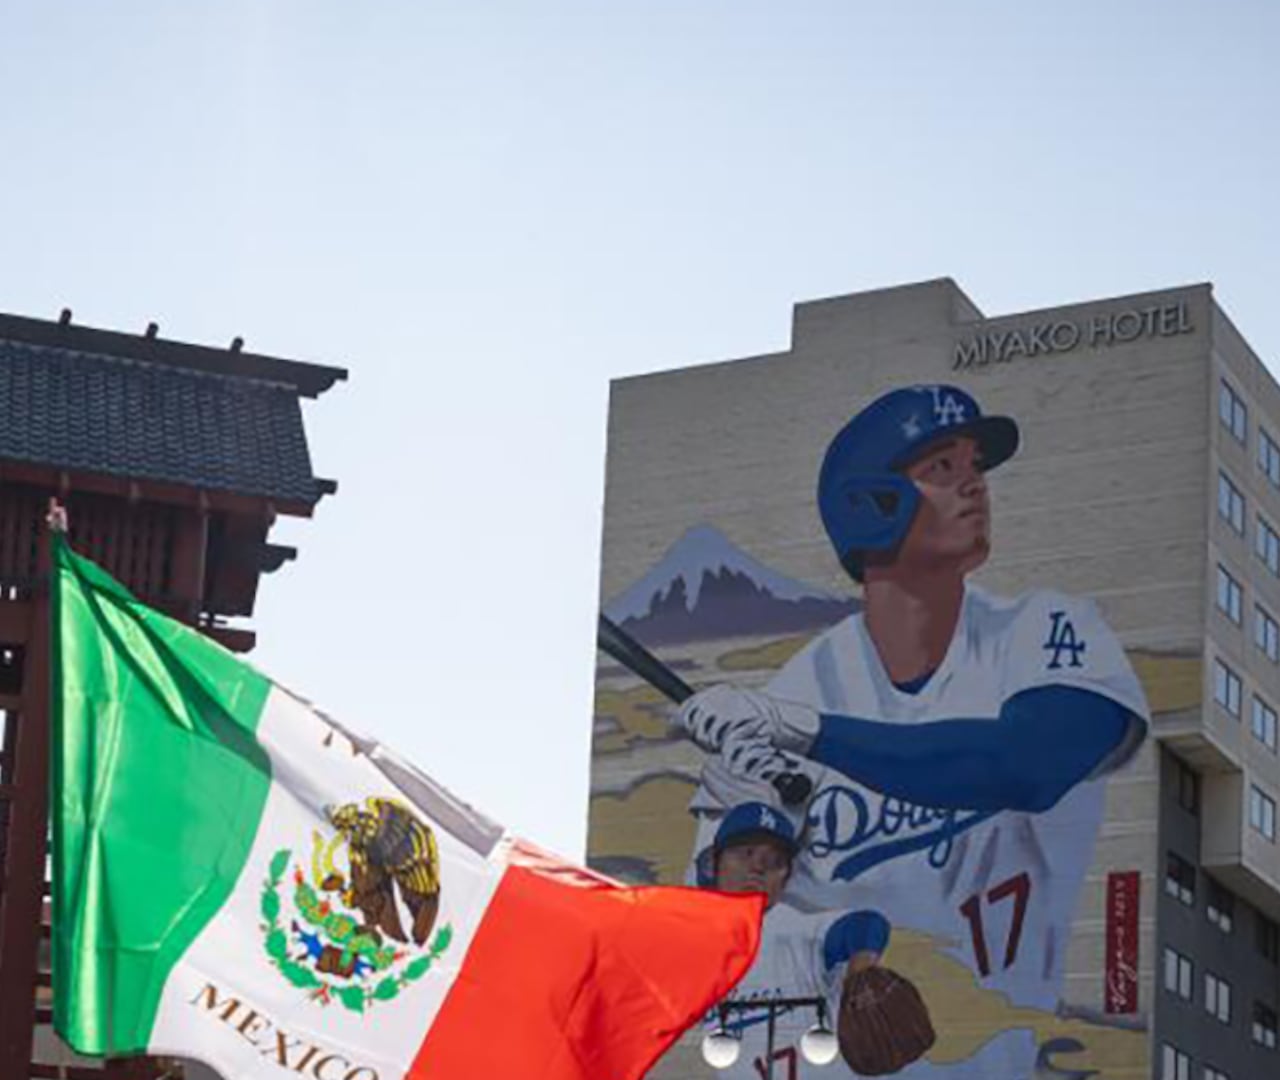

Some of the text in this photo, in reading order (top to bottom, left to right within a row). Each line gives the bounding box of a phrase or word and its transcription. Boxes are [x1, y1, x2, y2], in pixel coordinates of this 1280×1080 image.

[952, 302, 1193, 370] MIYAKO HOTEL
[930, 387, 965, 425] LA
[1042, 611, 1086, 669] LA
[958, 871, 1031, 977] 17
